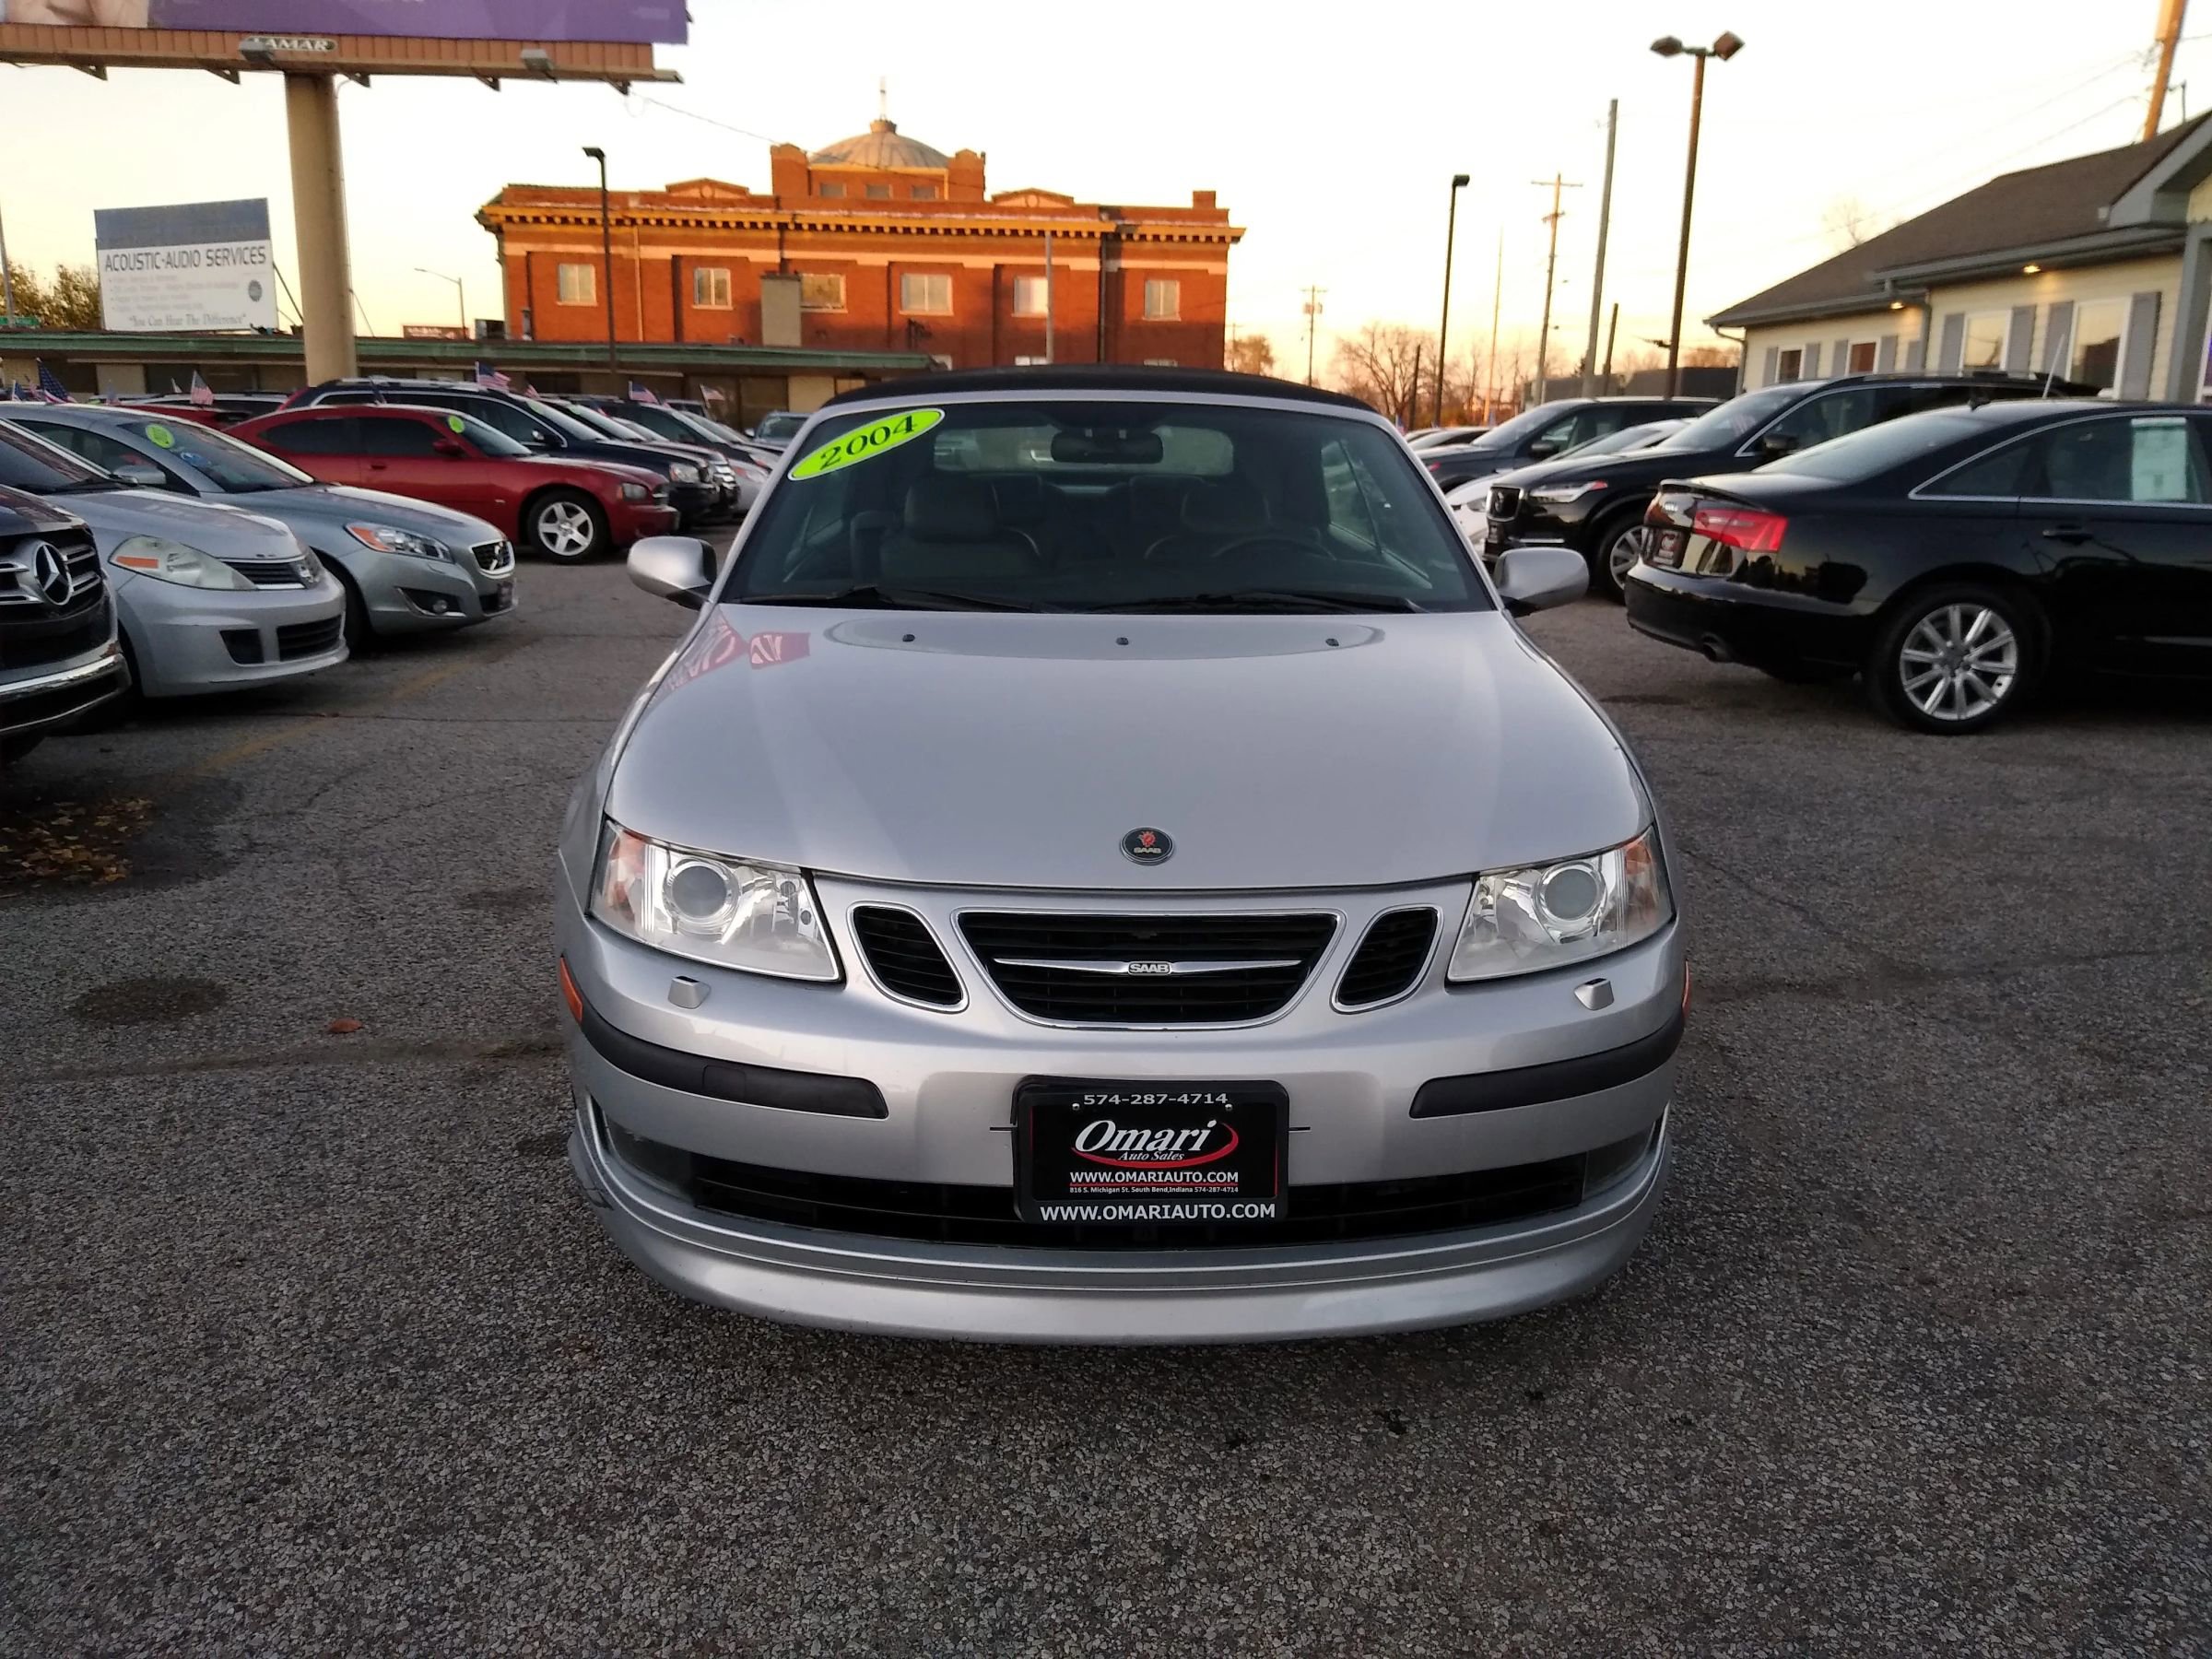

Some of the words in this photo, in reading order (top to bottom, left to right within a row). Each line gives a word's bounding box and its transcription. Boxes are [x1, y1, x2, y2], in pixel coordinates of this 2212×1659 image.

[206, 245, 266, 267] SERVICES
[819, 415, 918, 470] 2004
[1130, 963, 1169, 973] SAAB
[1083, 1093, 1229, 1105] 574-287-4714
[1075, 1119, 1218, 1152] Omari
[1117, 1151, 1150, 1161] Auto
[1150, 1151, 1185, 1161] Sales
[1069, 1171, 1239, 1182] WWW.OMARIAUTO.COM
[1090, 1186, 1121, 1194] Michigan
[1040, 1203, 1276, 1221] WWW.OMARIAUTO.COM
